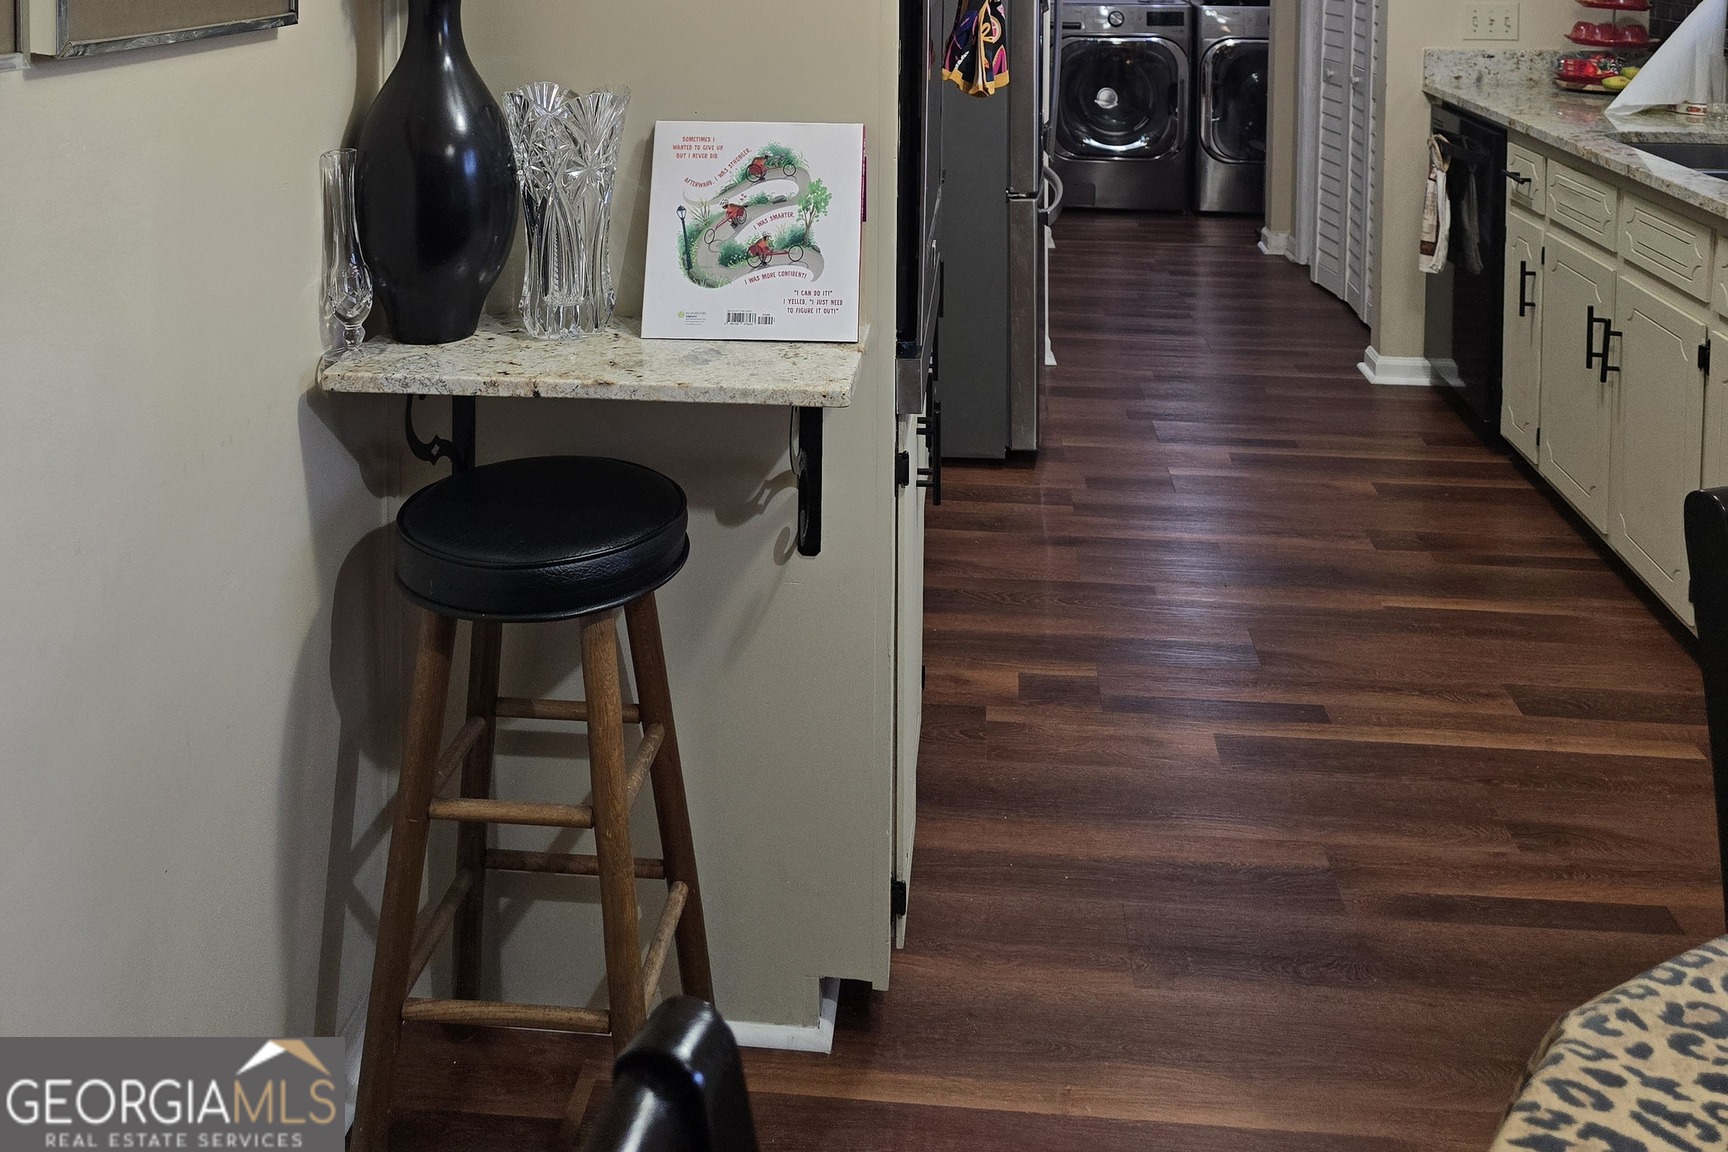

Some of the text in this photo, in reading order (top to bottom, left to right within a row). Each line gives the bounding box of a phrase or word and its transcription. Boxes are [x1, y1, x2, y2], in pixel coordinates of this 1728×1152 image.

[718, 168, 729, 179] WAS
[757, 219, 768, 228] WAS
[748, 276, 760, 284] WAS
[761, 271, 776, 279] MORE
